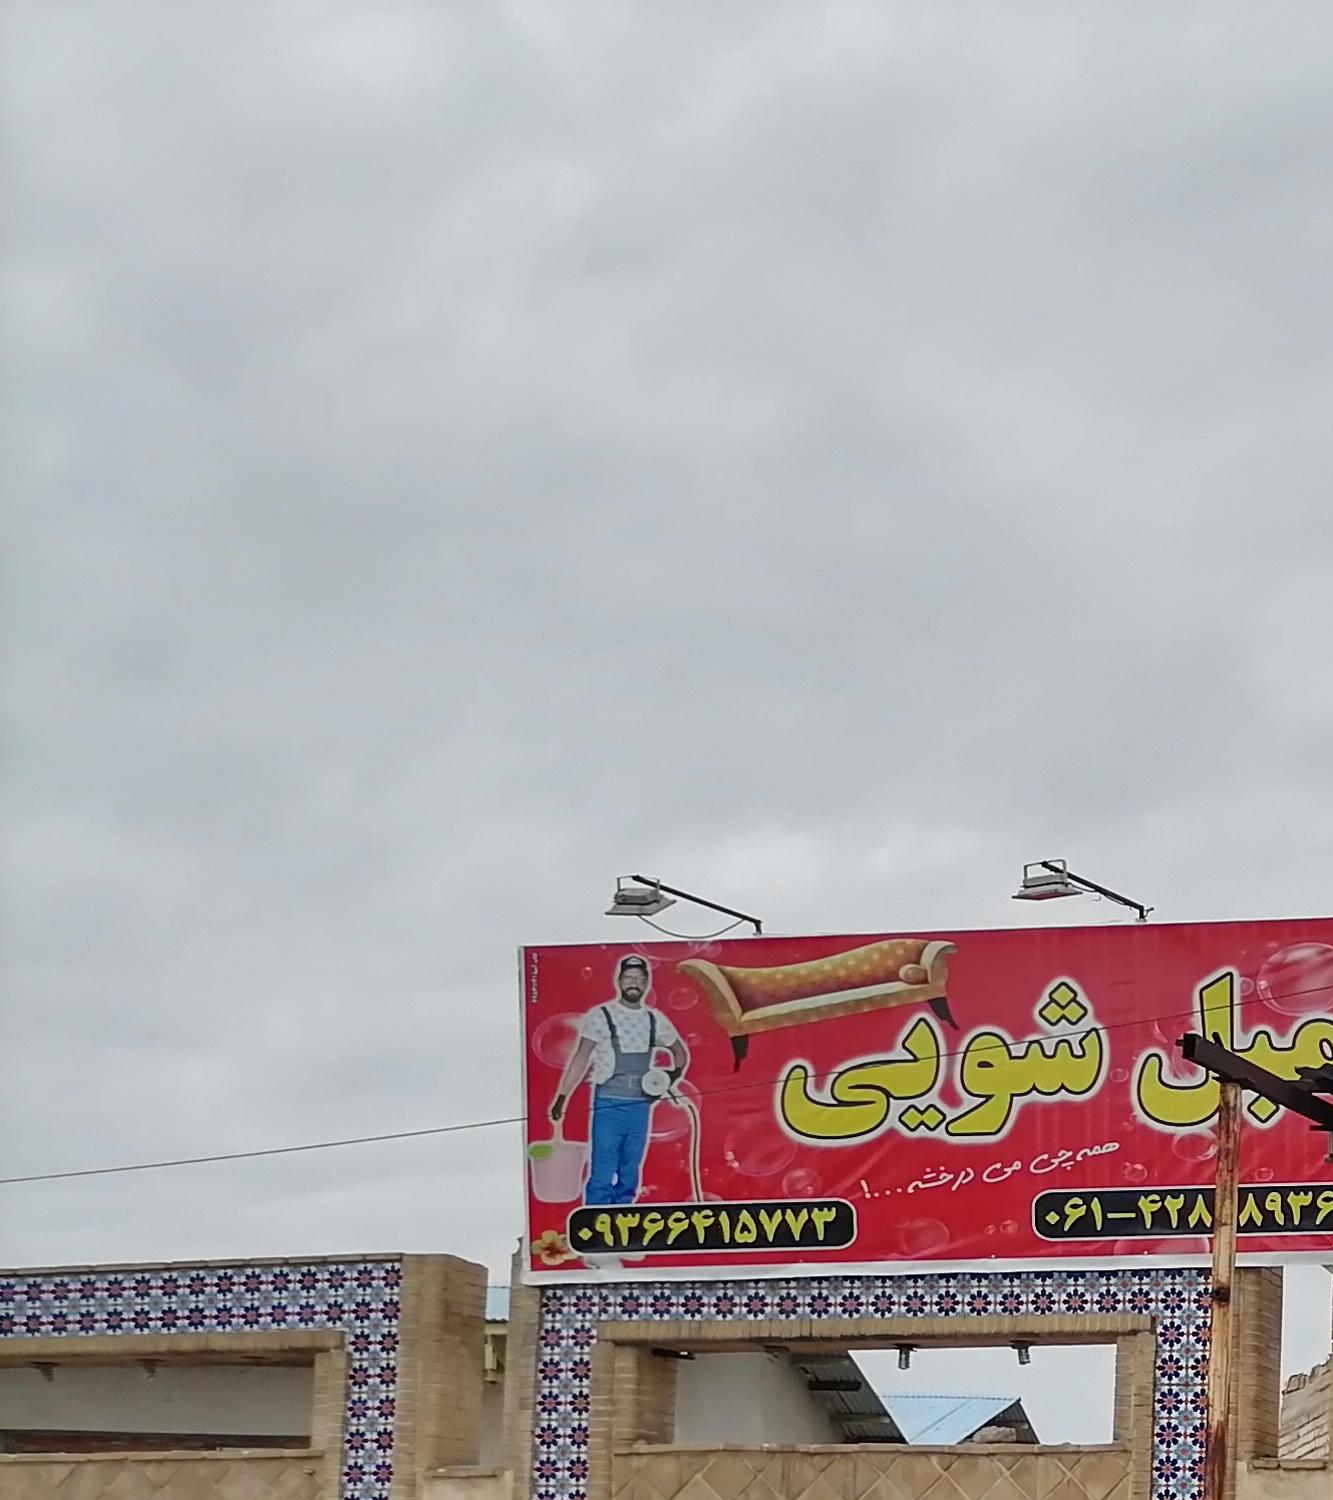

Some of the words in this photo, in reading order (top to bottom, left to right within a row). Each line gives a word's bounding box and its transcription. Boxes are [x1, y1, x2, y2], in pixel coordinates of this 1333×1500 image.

[781, 981, 1104, 1138] شویی
[1029, 1149, 1073, 1173] چی
[1076, 1141, 1120, 1161] همه
[982, 1160, 1022, 1183] می
[577, 1206, 837, 1247] ۰۹۳۶۶۴۱۵۷۷۳
